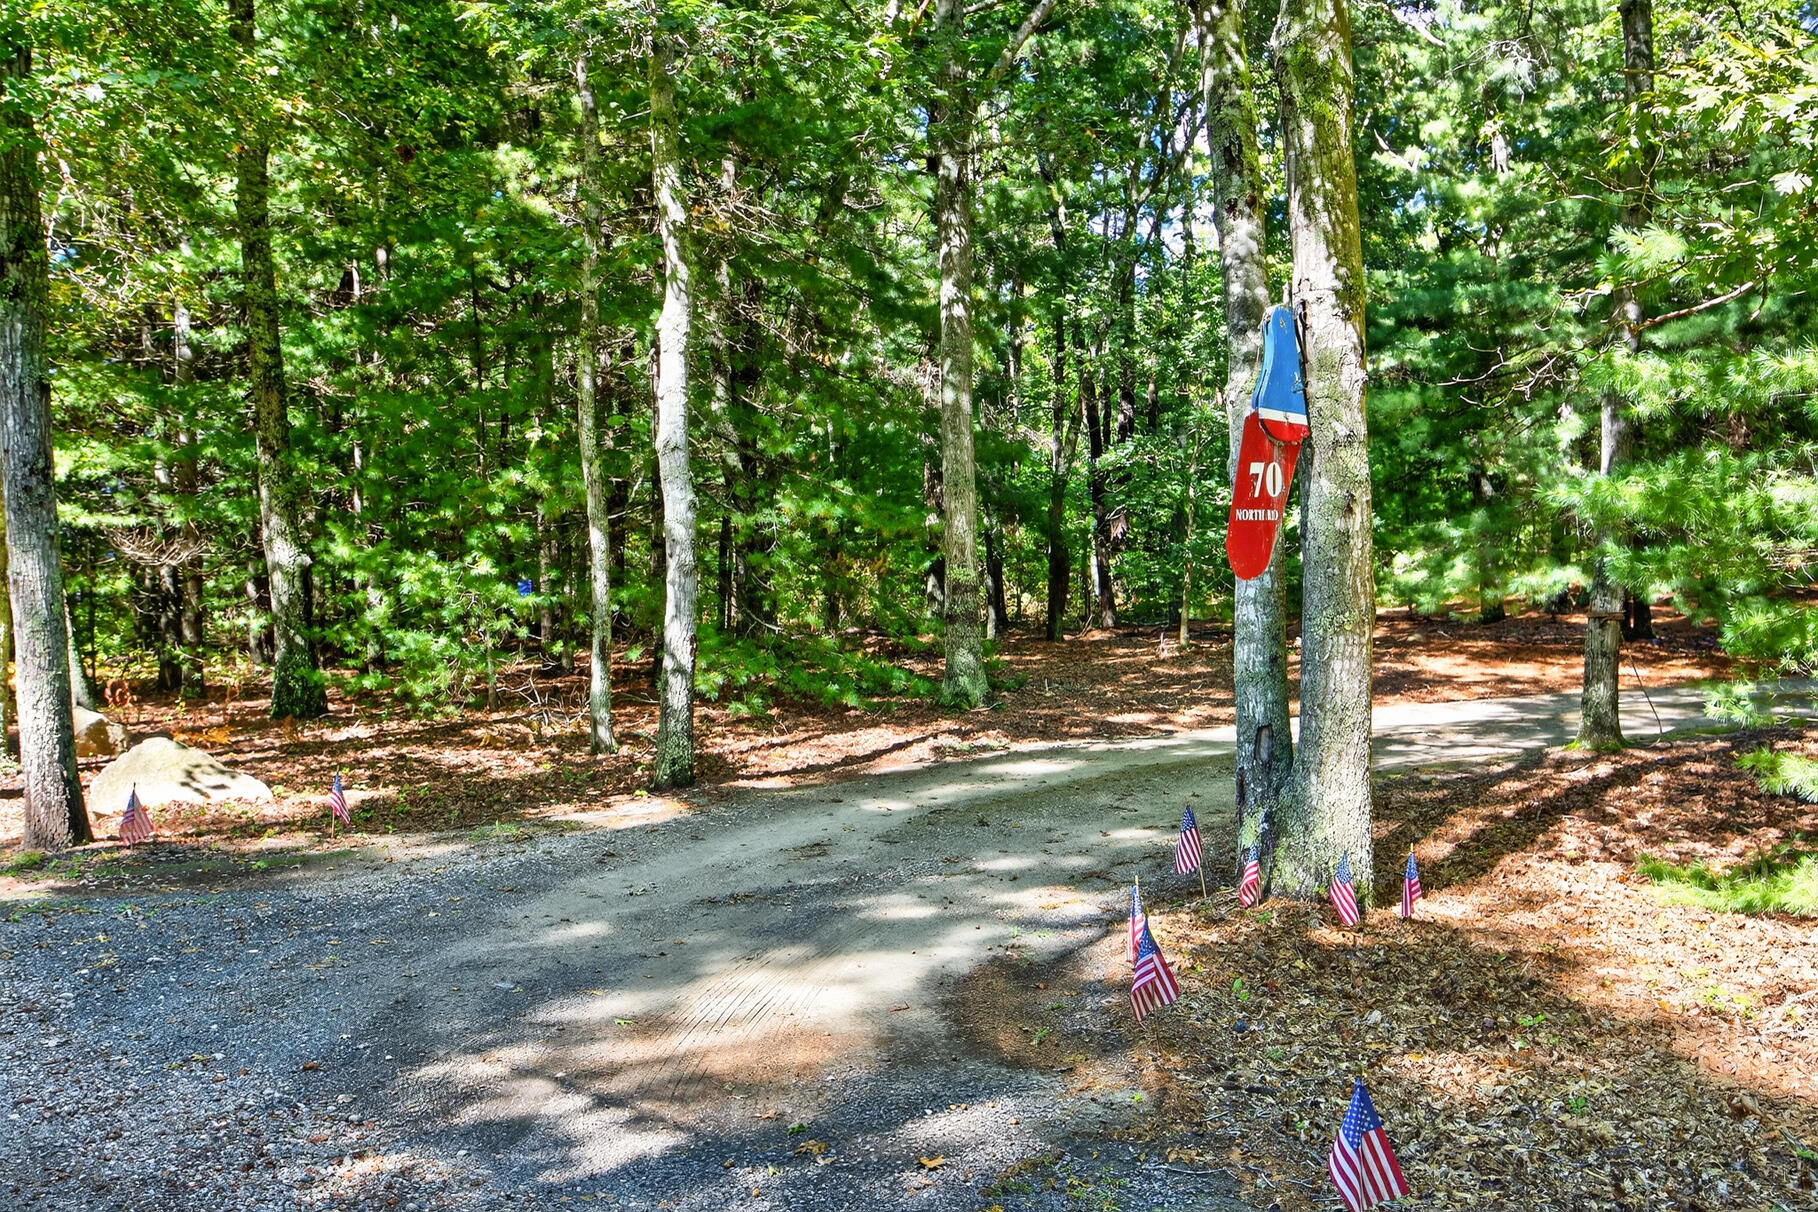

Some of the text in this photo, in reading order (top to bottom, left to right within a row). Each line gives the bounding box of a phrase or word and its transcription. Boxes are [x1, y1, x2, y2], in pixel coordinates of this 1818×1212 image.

[1249, 461, 1283, 498] 70
[1235, 508, 1279, 521] NORTH RD
